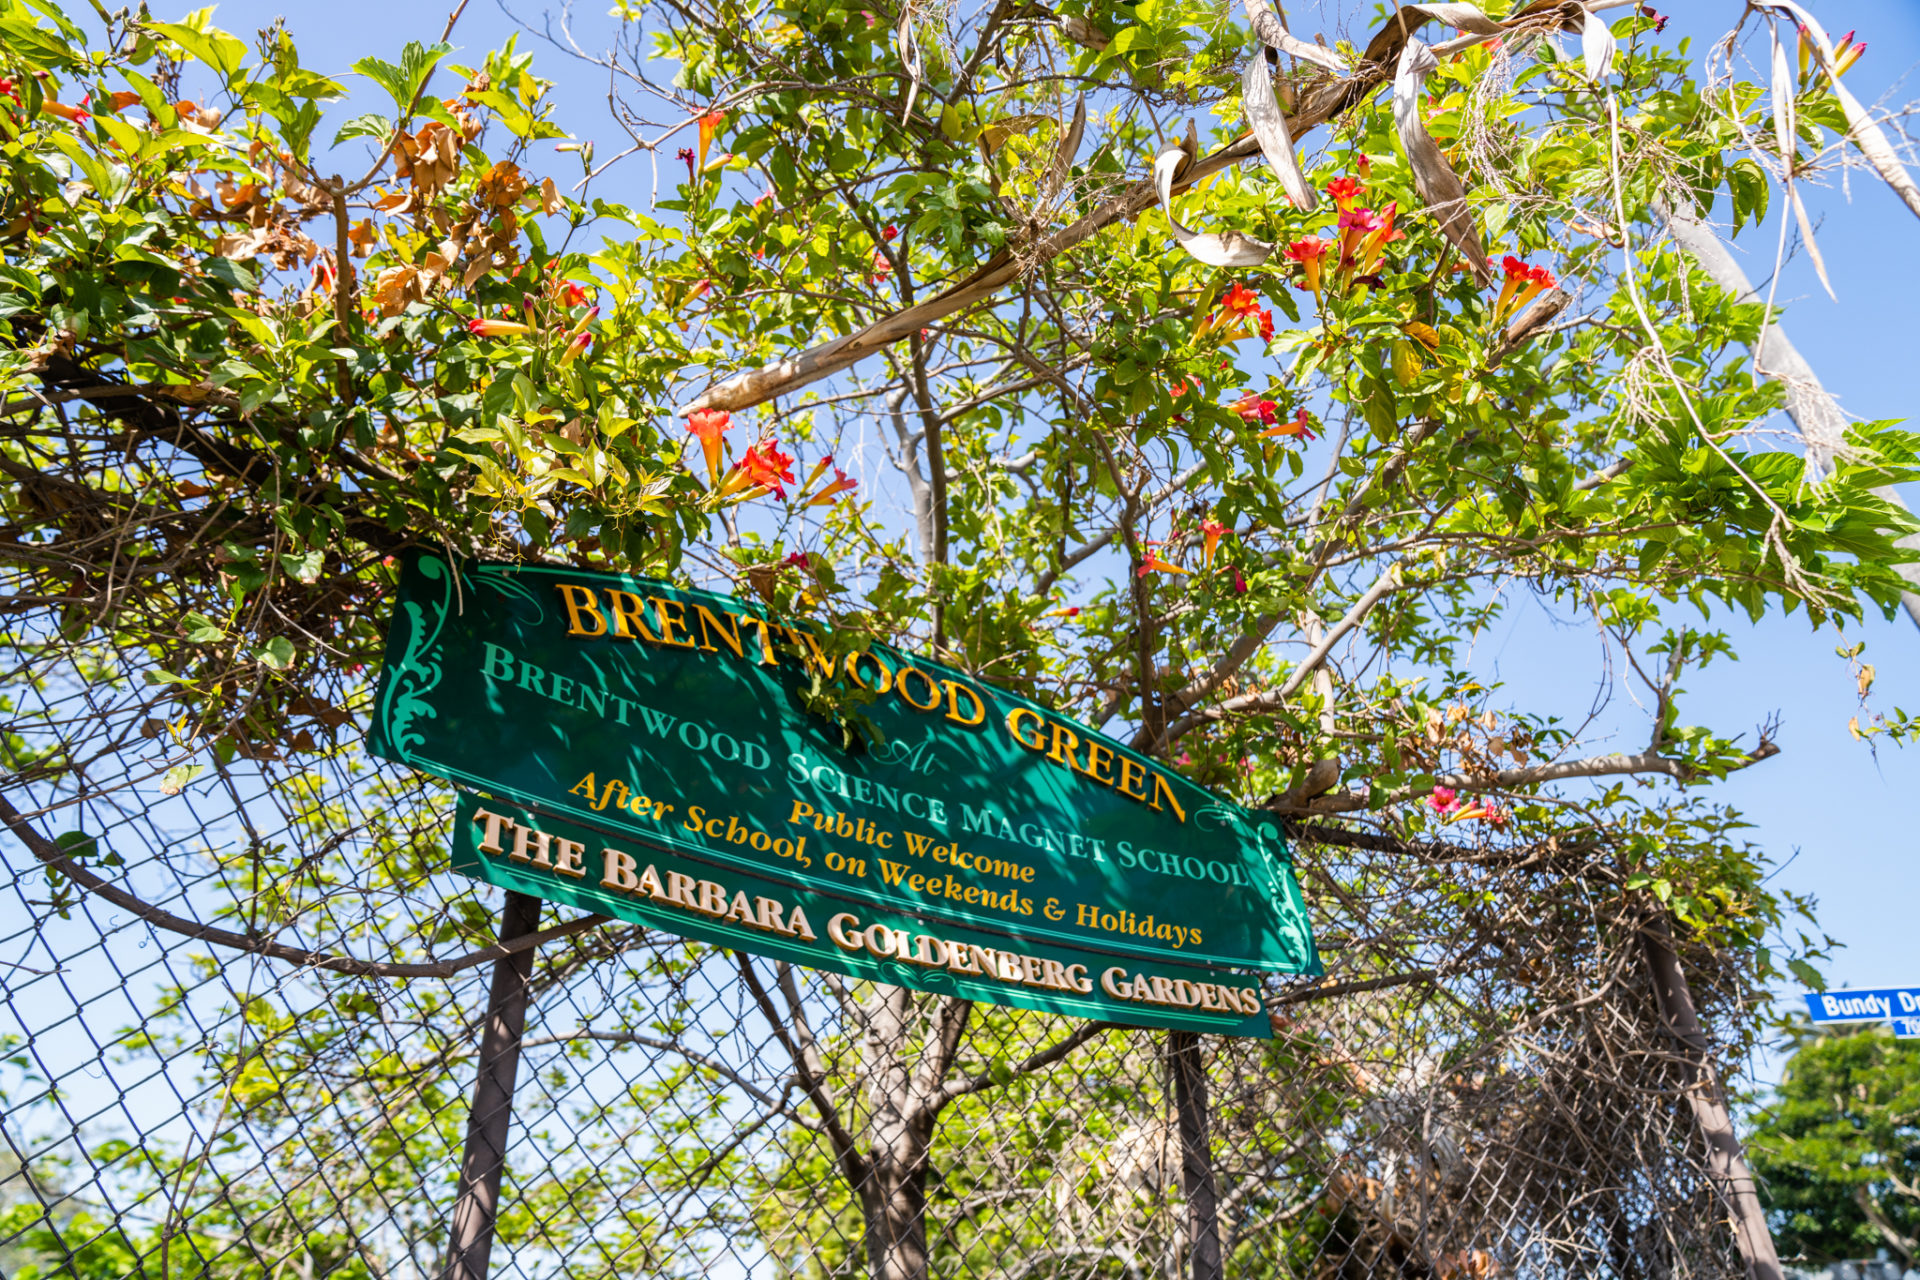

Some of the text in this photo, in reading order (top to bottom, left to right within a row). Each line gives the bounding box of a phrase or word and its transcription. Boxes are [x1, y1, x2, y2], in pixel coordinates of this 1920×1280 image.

[480, 641, 1250, 887] BRENTWOOD SCIENCE MAGNET SCHOOL
[1004, 707, 1186, 823] GREEN
[473, 807, 1261, 1016] THE BARBARA GOLDENBERG GARDENS
[568, 771, 1203, 949] After School, on Weekends & Holidays
[788, 800, 1036, 883] Public Welcome
[1821, 993, 1891, 1018] Bundy
